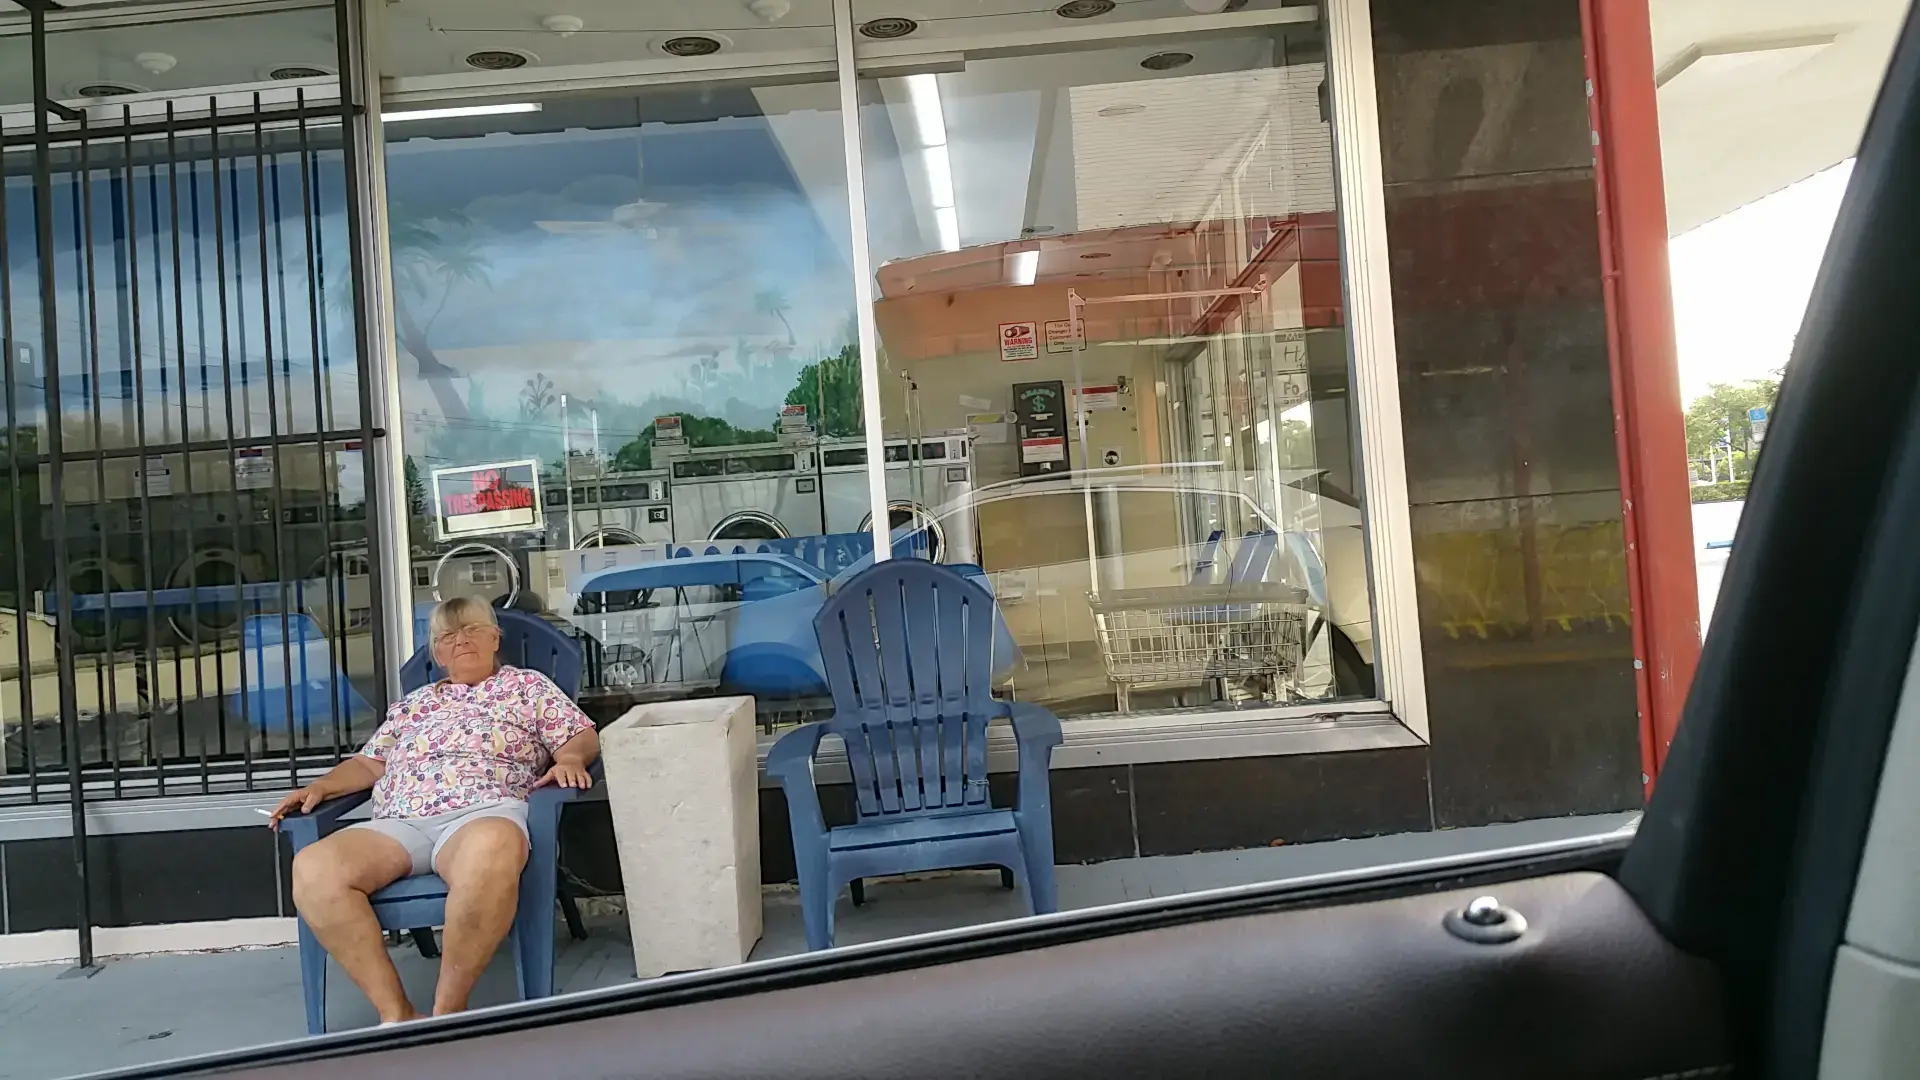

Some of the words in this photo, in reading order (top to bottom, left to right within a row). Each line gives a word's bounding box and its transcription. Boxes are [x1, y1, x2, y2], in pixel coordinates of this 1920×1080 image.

[1004, 337, 1032, 346] WARNING
[472, 469, 500, 490] NO
[444, 487, 532, 514] TRESPASSING
